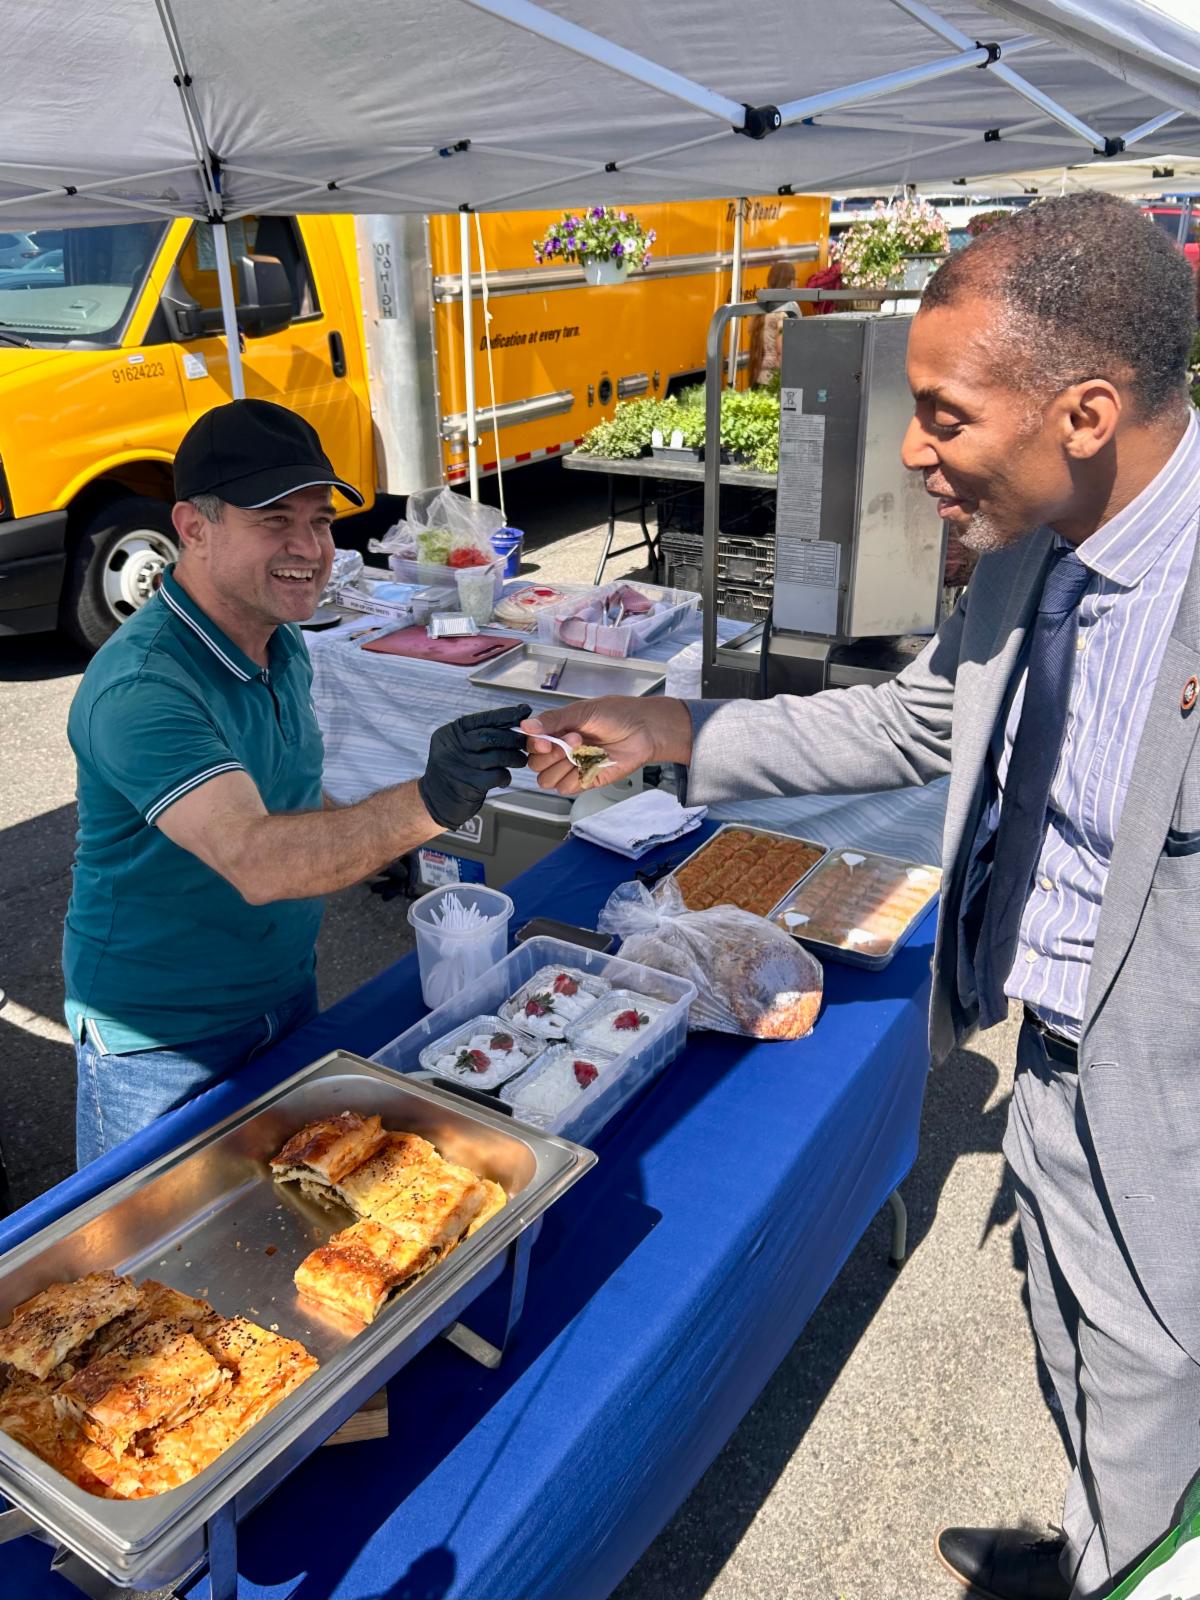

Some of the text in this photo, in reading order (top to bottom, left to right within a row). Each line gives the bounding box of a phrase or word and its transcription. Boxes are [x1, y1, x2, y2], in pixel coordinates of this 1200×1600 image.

[528, 330, 538, 344] at
[539, 328, 562, 343] every
[112, 362, 165, 383] 91624223
